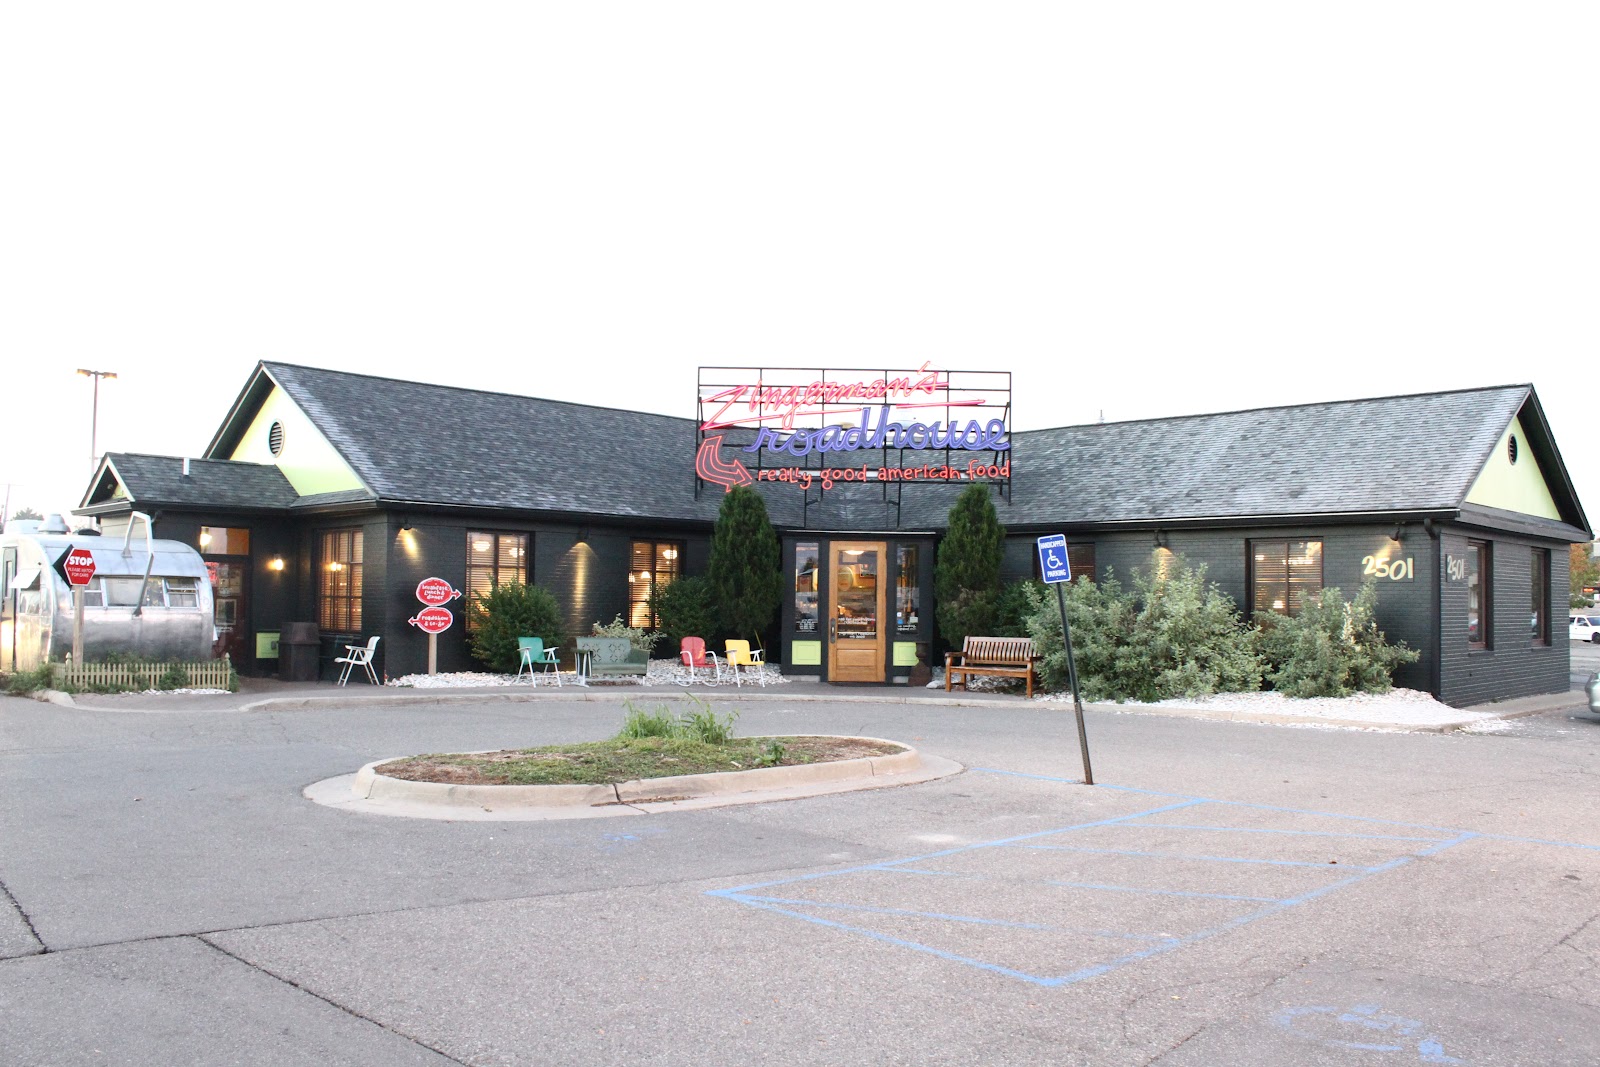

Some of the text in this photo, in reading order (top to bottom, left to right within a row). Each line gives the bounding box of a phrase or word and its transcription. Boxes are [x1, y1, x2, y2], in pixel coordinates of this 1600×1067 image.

[700, 360, 952, 430] Zingerman's
[743, 406, 1012, 457] roadhouse
[758, 459, 1012, 490] really good american food
[1040, 540, 1065, 549] HANDICAPPED
[69, 556, 93, 566] STOP
[1047, 569, 1066, 577] PARKING
[1361, 555, 1414, 581] 2501
[1447, 555, 1465, 581] 2501
